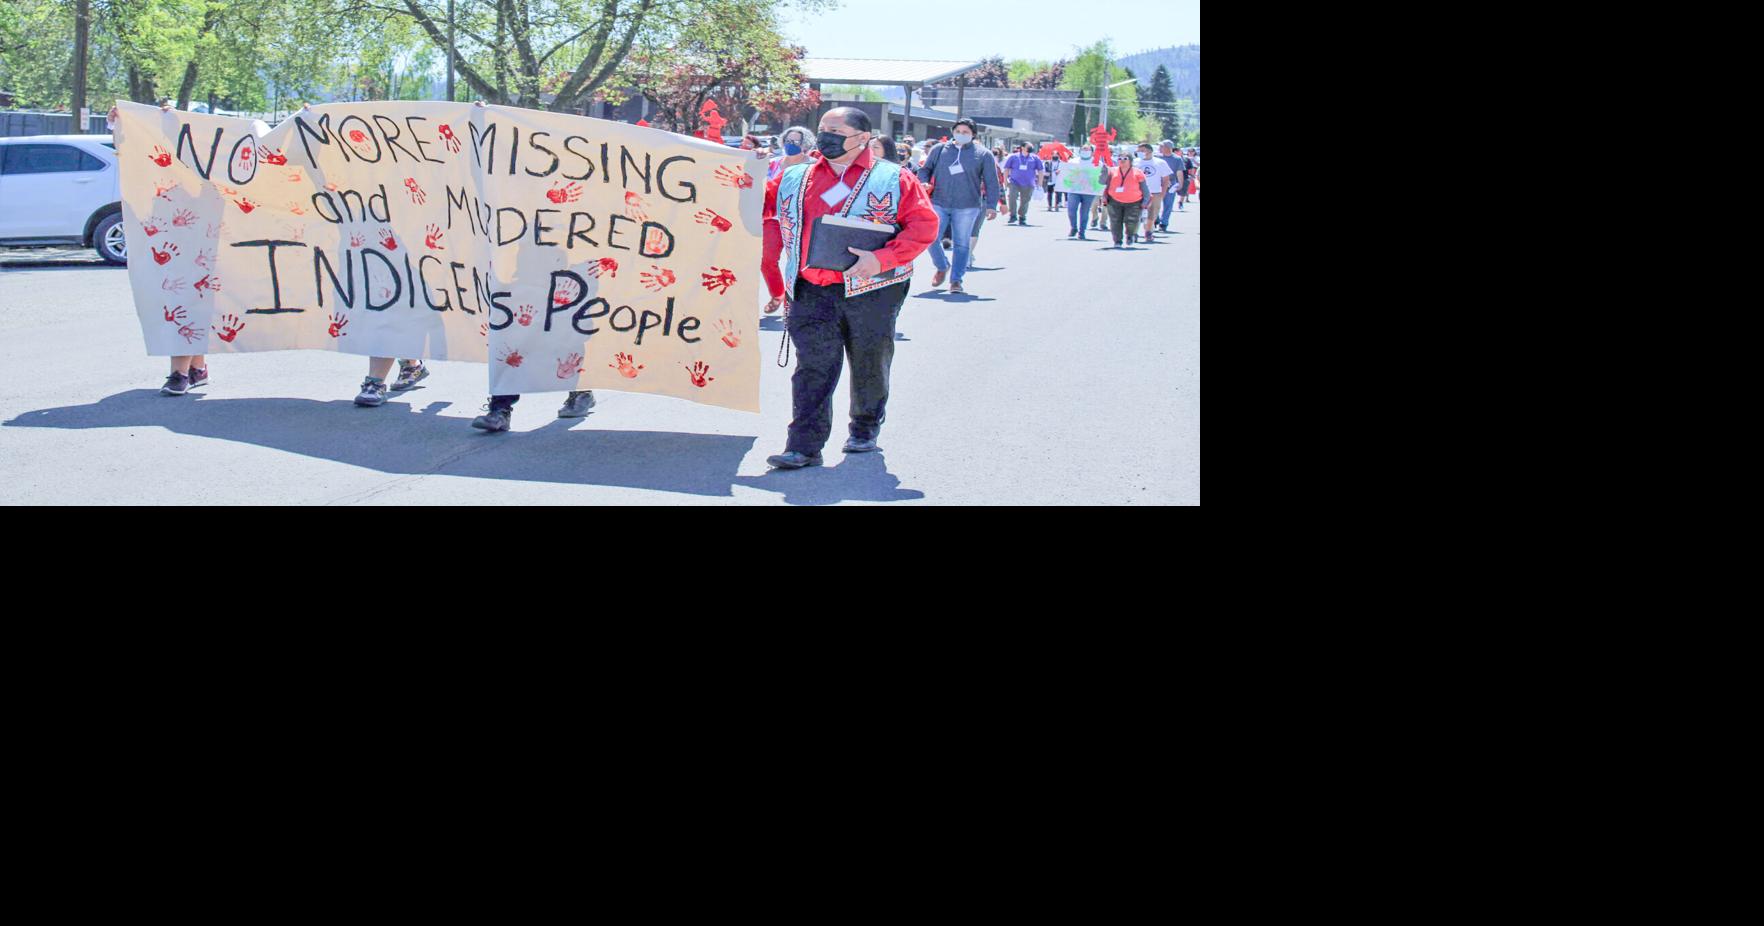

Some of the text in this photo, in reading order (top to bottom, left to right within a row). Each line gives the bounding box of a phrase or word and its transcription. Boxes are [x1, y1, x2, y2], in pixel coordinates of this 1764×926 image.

[176, 113, 697, 204] NO MORE MISSING
[311, 184, 391, 224] and
[544, 269, 702, 345] People
